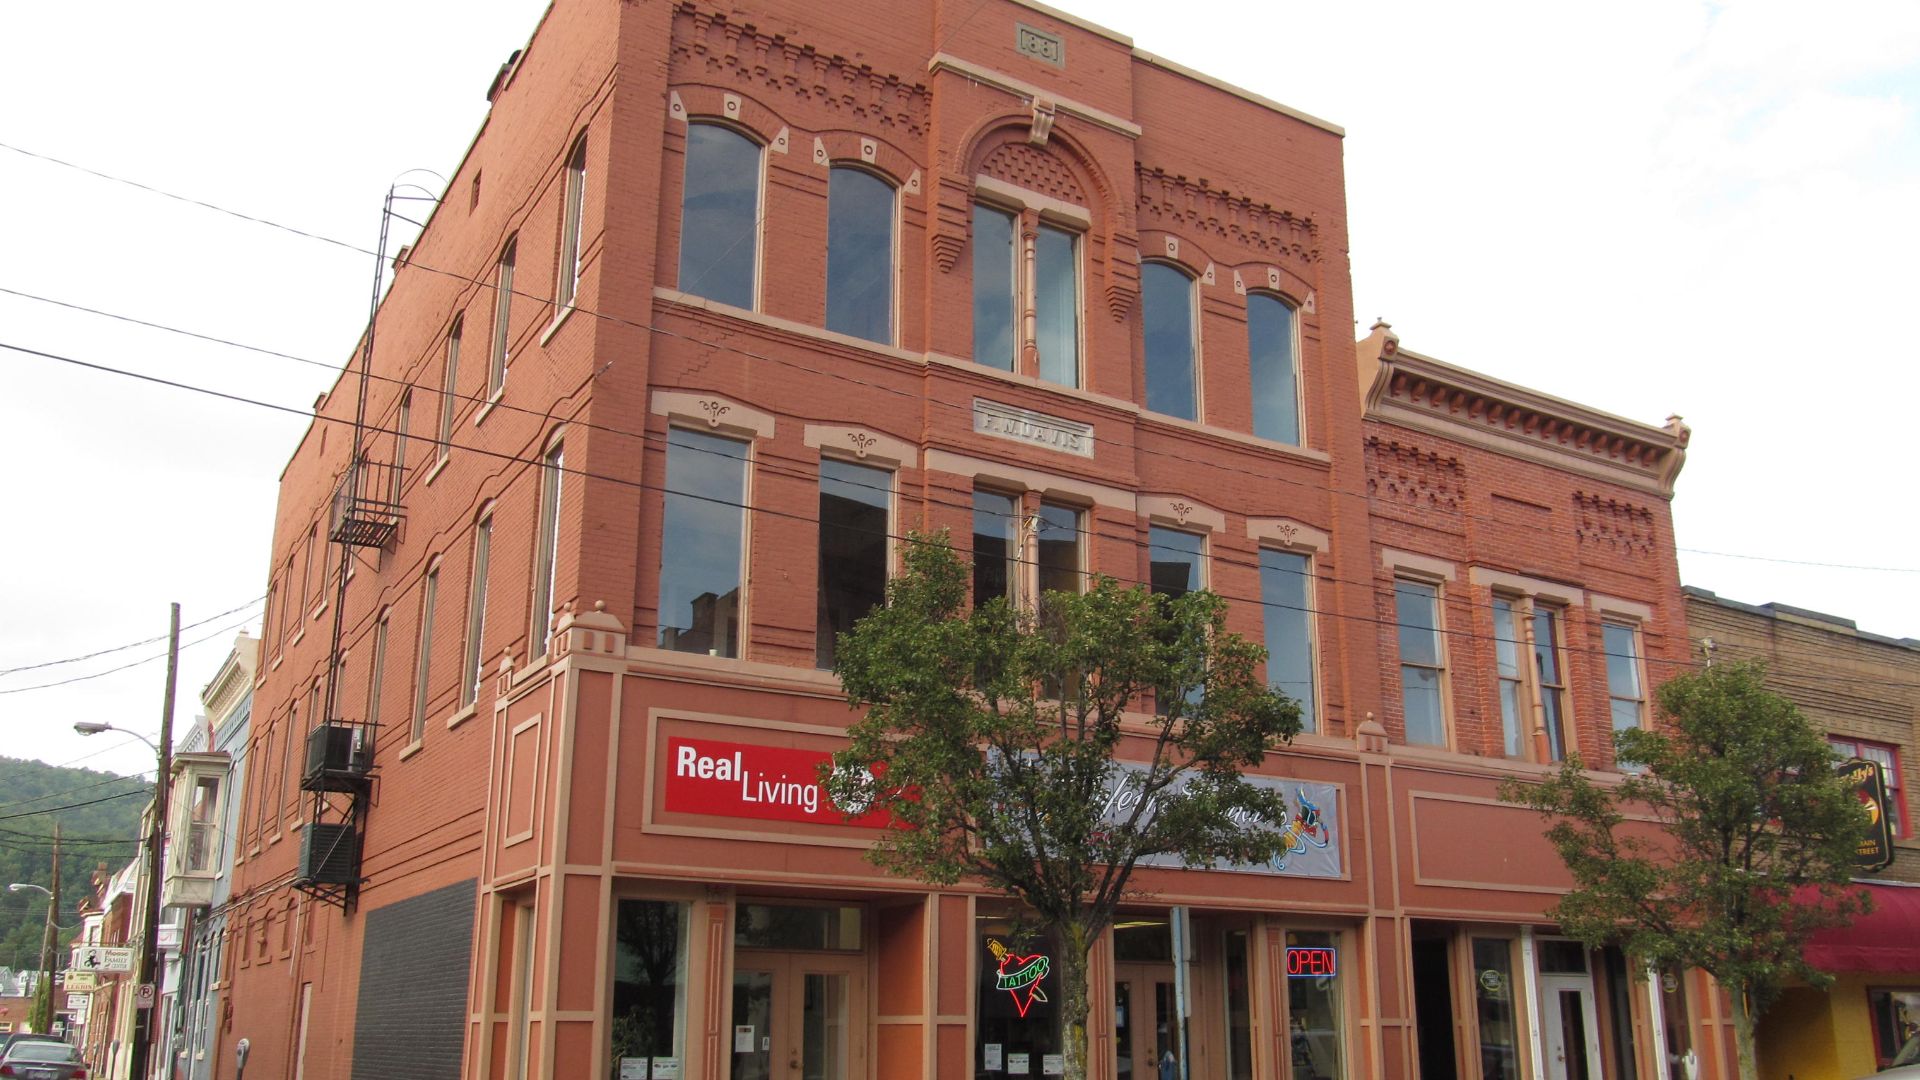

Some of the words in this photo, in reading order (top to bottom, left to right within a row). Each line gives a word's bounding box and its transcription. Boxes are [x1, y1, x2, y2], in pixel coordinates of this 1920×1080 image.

[676, 745, 742, 782] Real
[741, 771, 818, 814] Living
[1003, 958, 1046, 988] TATTOO
[1287, 950, 1335, 975] OPEN
